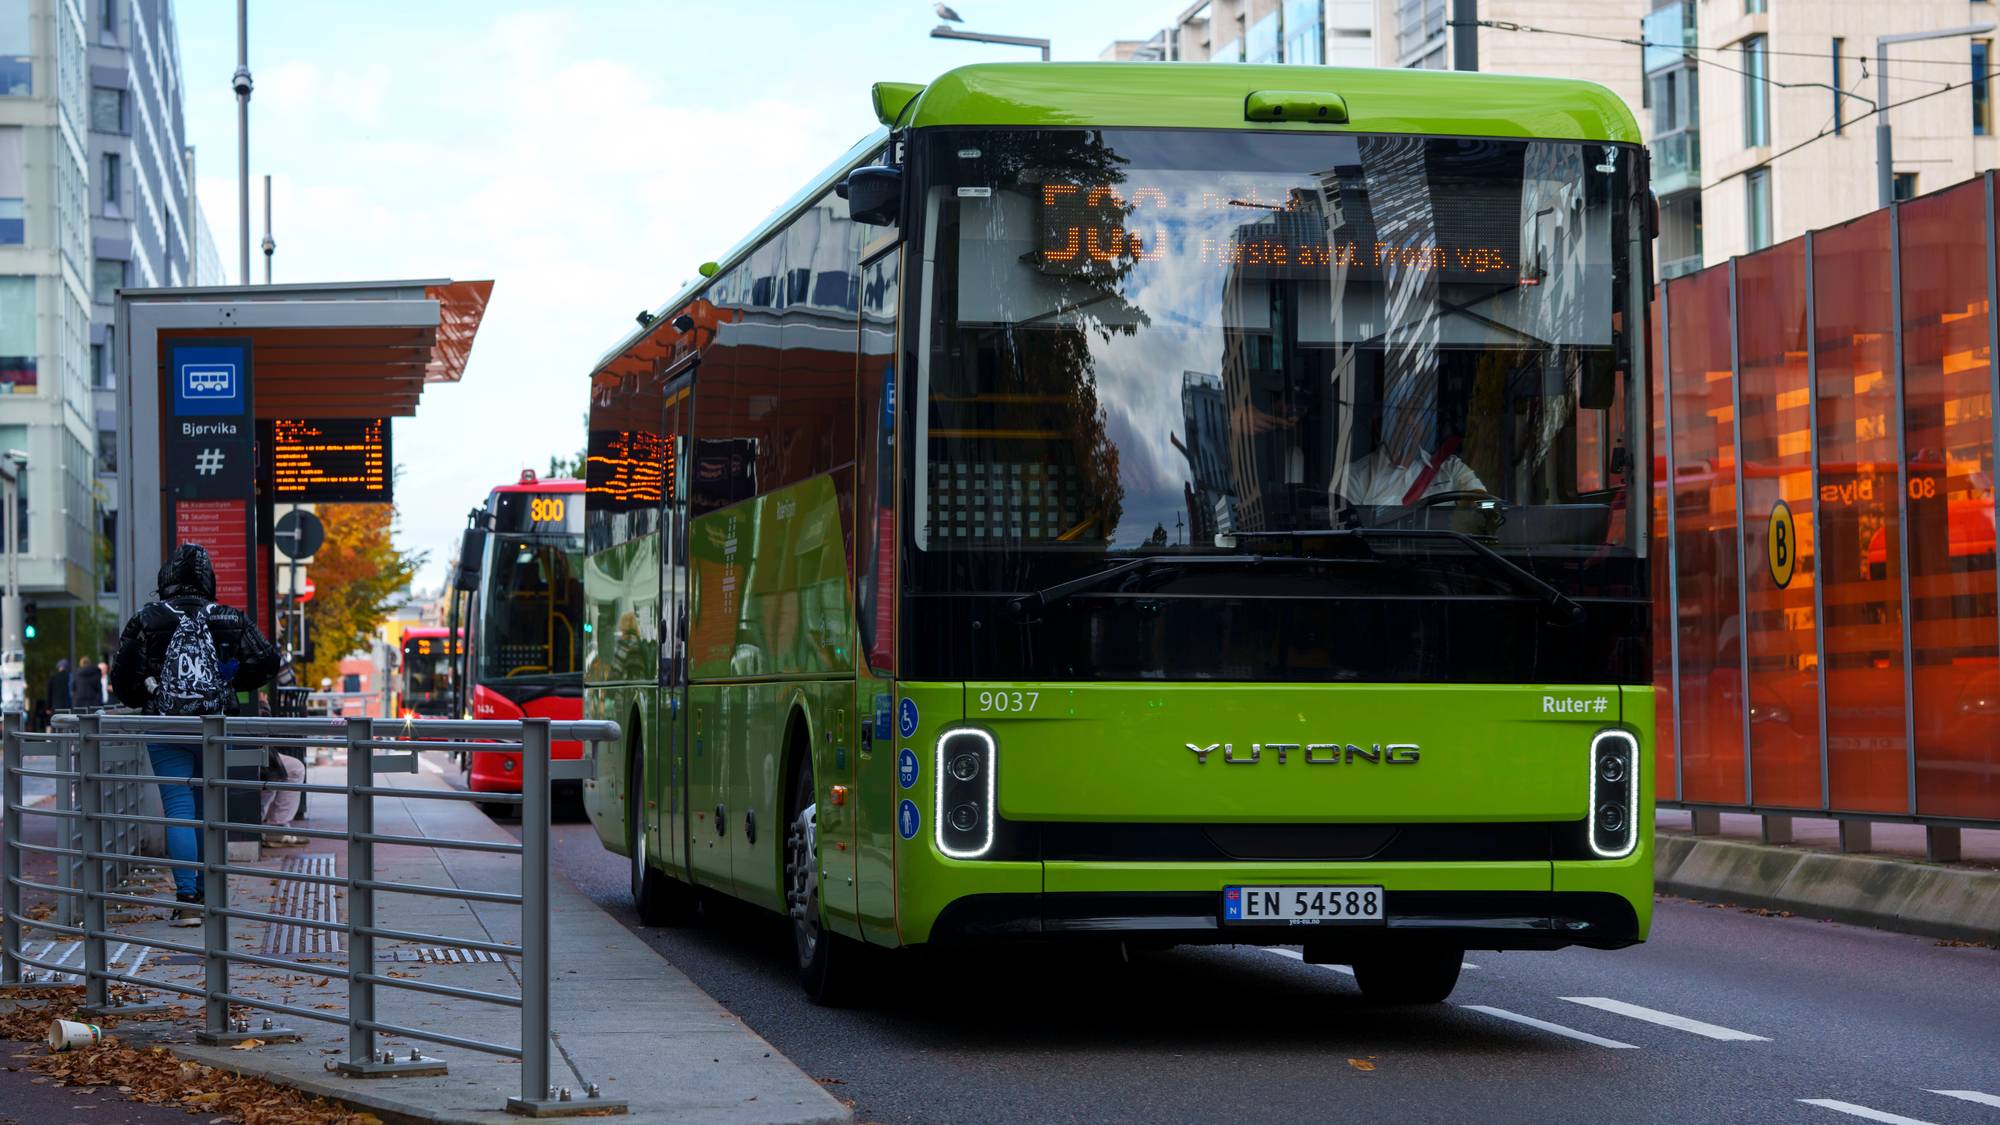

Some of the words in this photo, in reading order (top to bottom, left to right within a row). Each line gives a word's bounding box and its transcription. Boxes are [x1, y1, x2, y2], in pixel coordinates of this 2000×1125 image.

[1374, 242, 1446, 272] Frogn
[1456, 248, 1511, 273] vgs.
[183, 422, 237, 438] Bjørvika
[531, 498, 565, 522] 300
[1776, 520, 1788, 568] B
[978, 690, 1040, 713] 9037
[1541, 694, 1609, 715] Ruter#
[1185, 742, 1421, 766] YUTONG
[1229, 907, 1237, 916] N
[1247, 891, 1281, 916] EN
[1294, 891, 1378, 916] 54588
